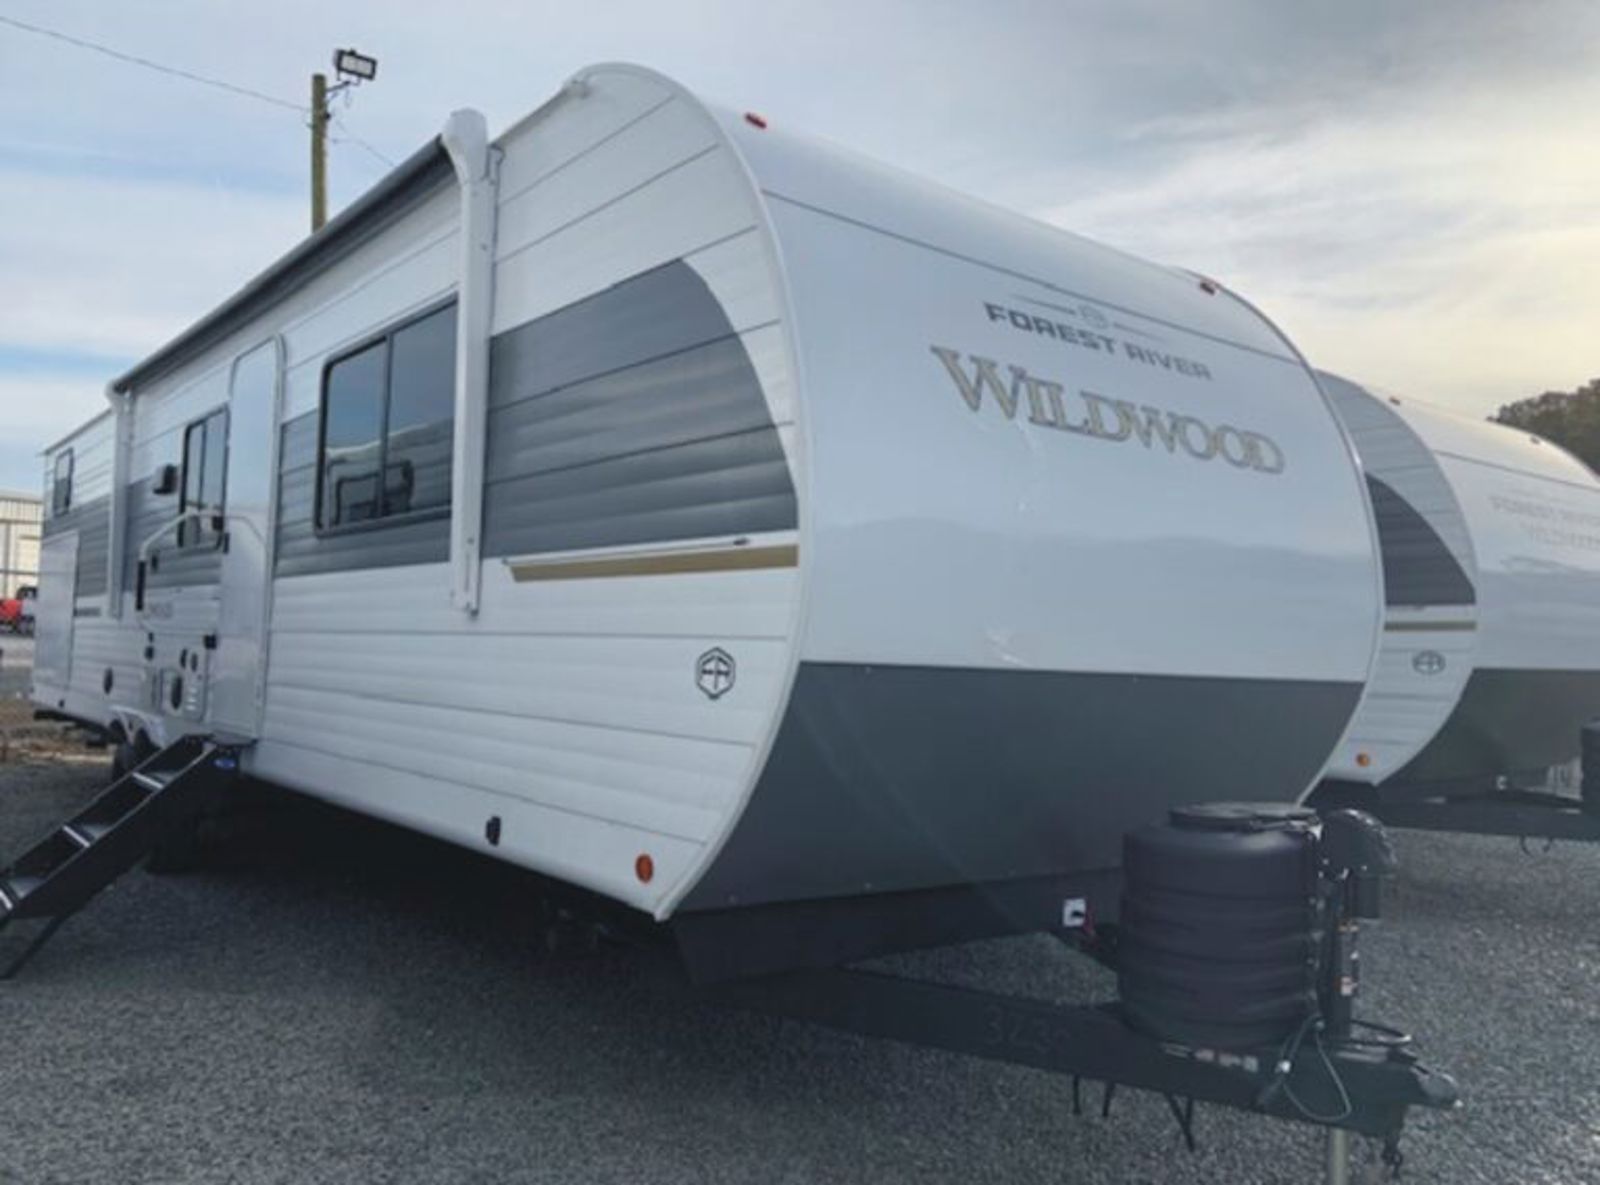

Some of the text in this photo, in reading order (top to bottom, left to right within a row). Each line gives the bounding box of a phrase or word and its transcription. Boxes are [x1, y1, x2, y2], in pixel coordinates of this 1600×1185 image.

[985, 303, 1213, 381] FOREST RIVER
[930, 345, 1285, 475] WILDWOOD
